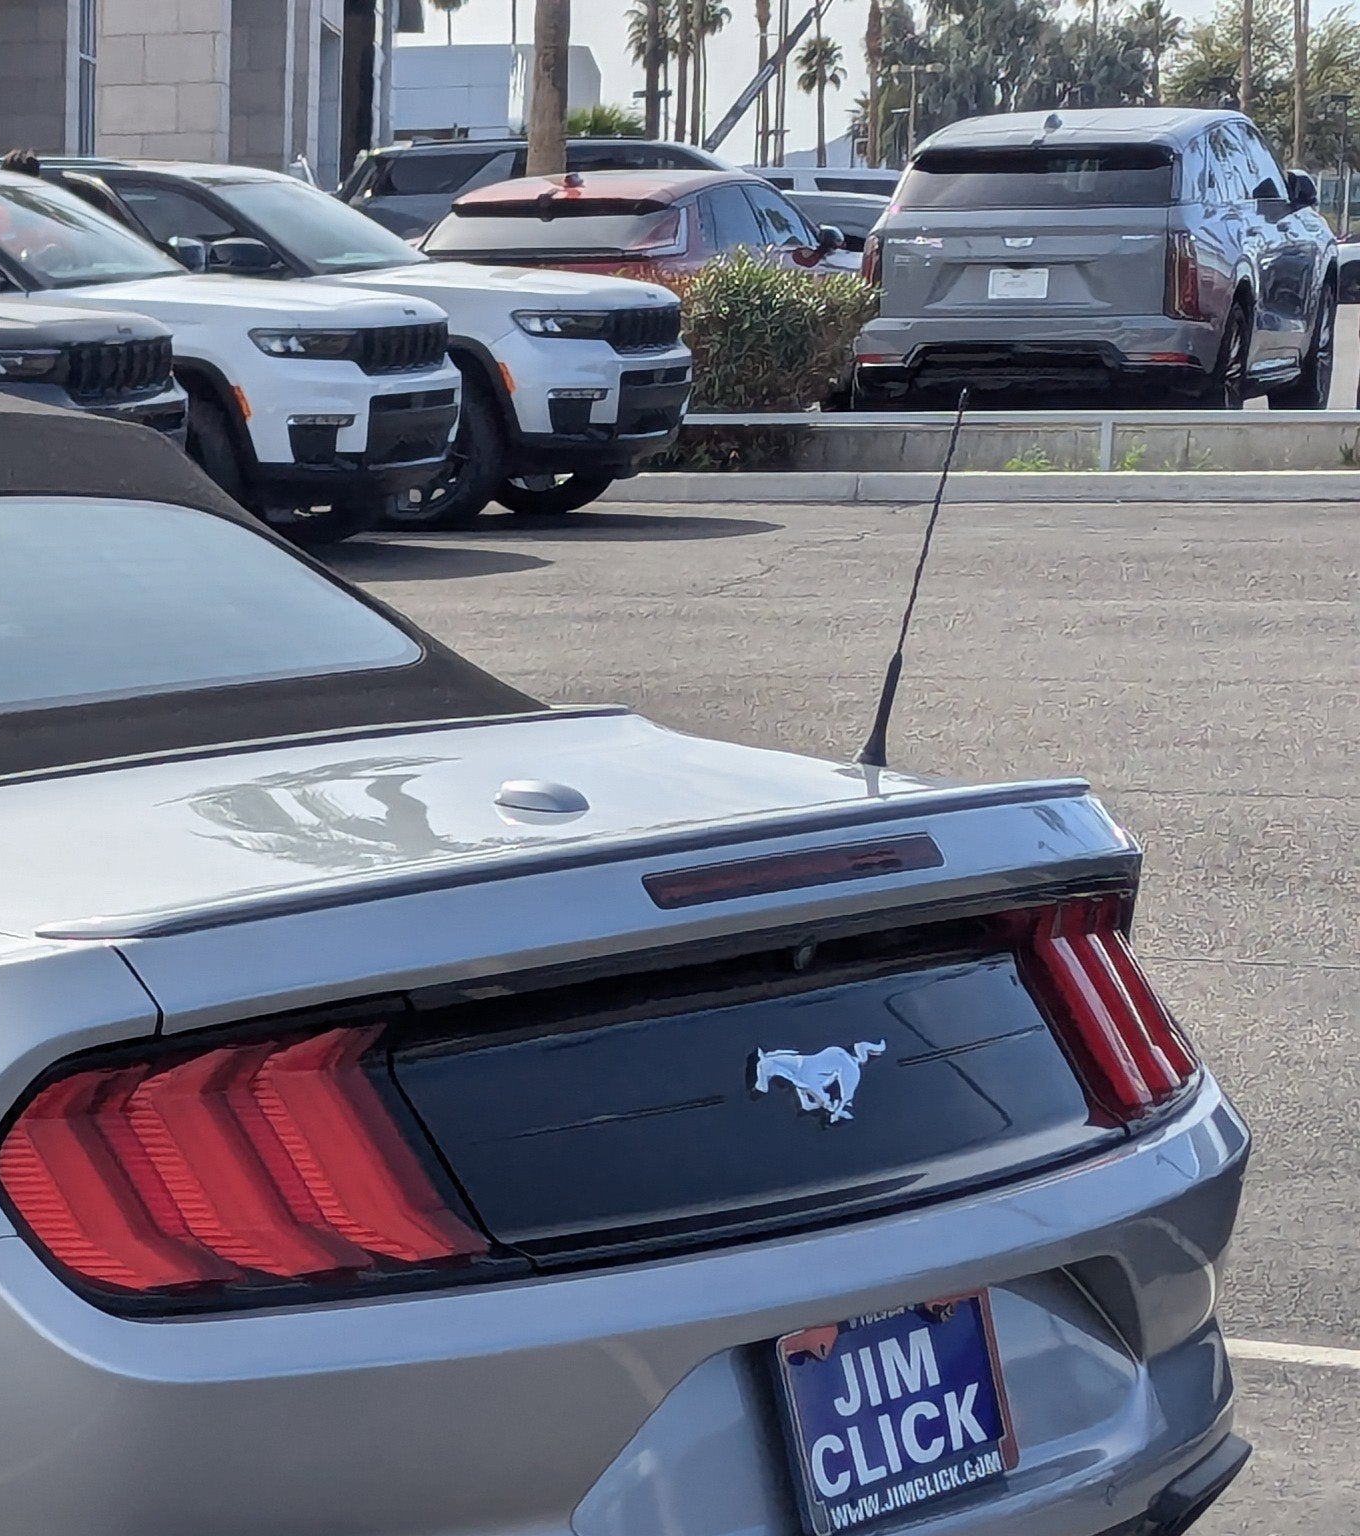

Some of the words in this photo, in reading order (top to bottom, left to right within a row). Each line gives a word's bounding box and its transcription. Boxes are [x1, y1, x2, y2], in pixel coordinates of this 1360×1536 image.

[834, 1327, 941, 1417] JIM
[811, 1382, 988, 1498] CLICK
[831, 1451, 1002, 1530] WWW.JIMCLICK.COM
